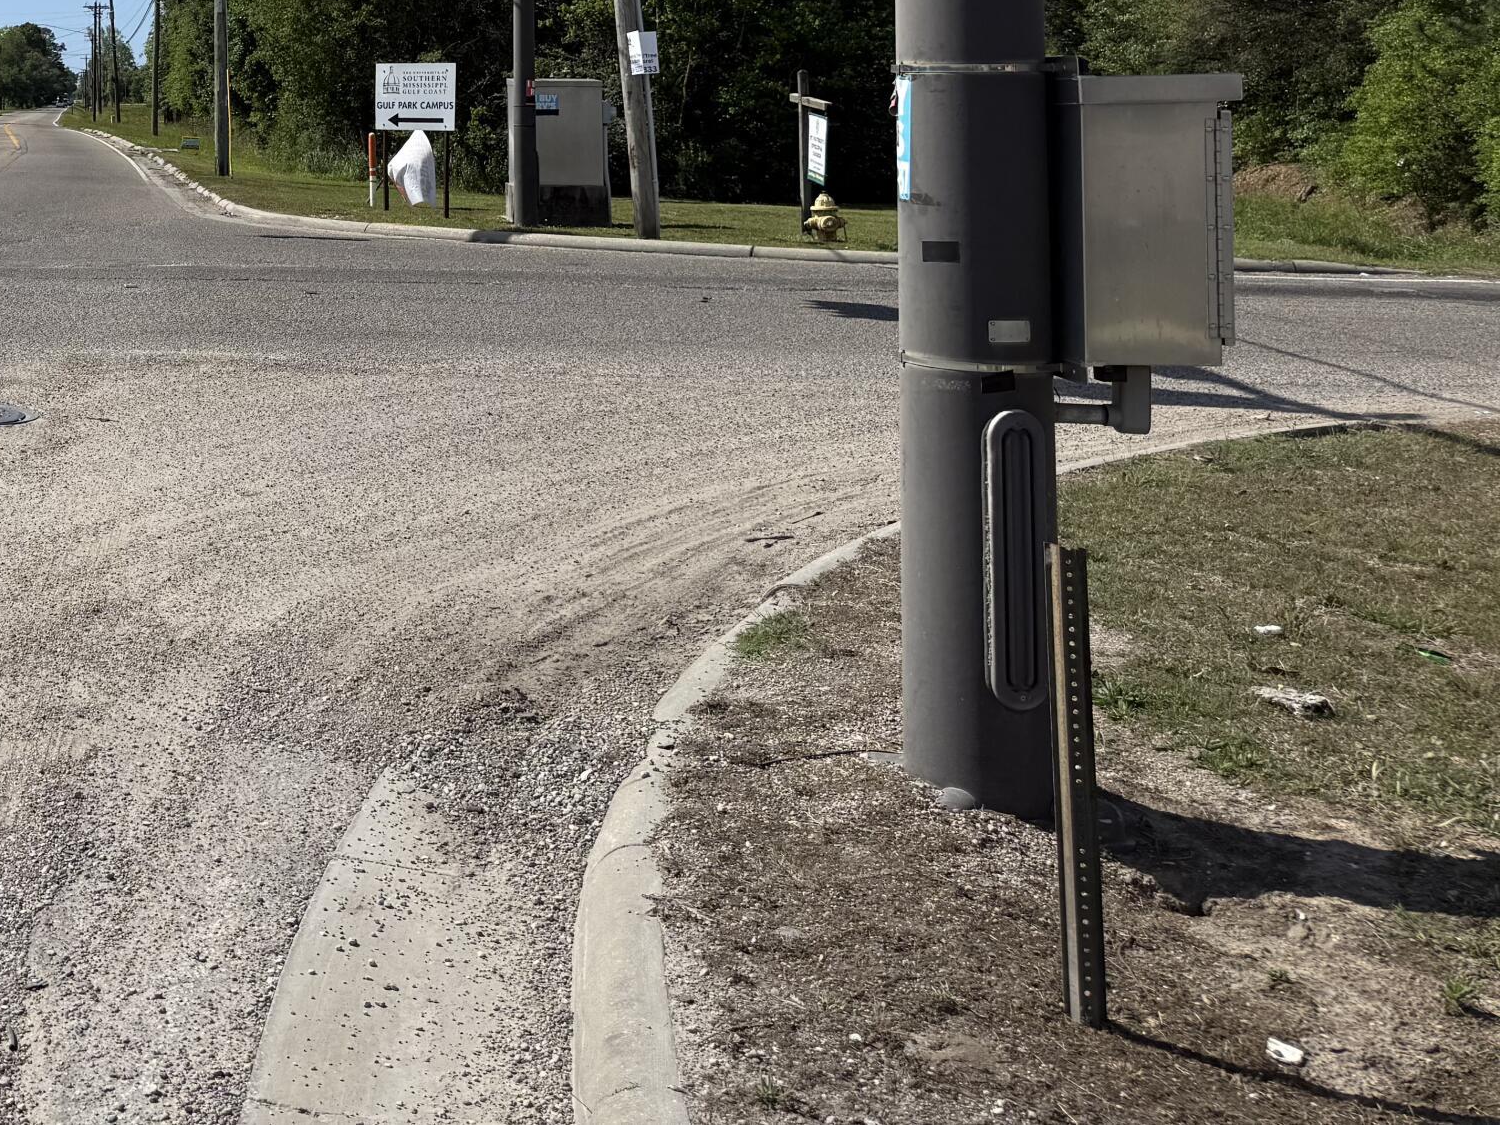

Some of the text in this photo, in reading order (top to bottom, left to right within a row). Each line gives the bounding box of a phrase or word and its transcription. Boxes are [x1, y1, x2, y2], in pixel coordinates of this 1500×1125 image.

[377, 101, 454, 110] GULF PARK CAMPUS
